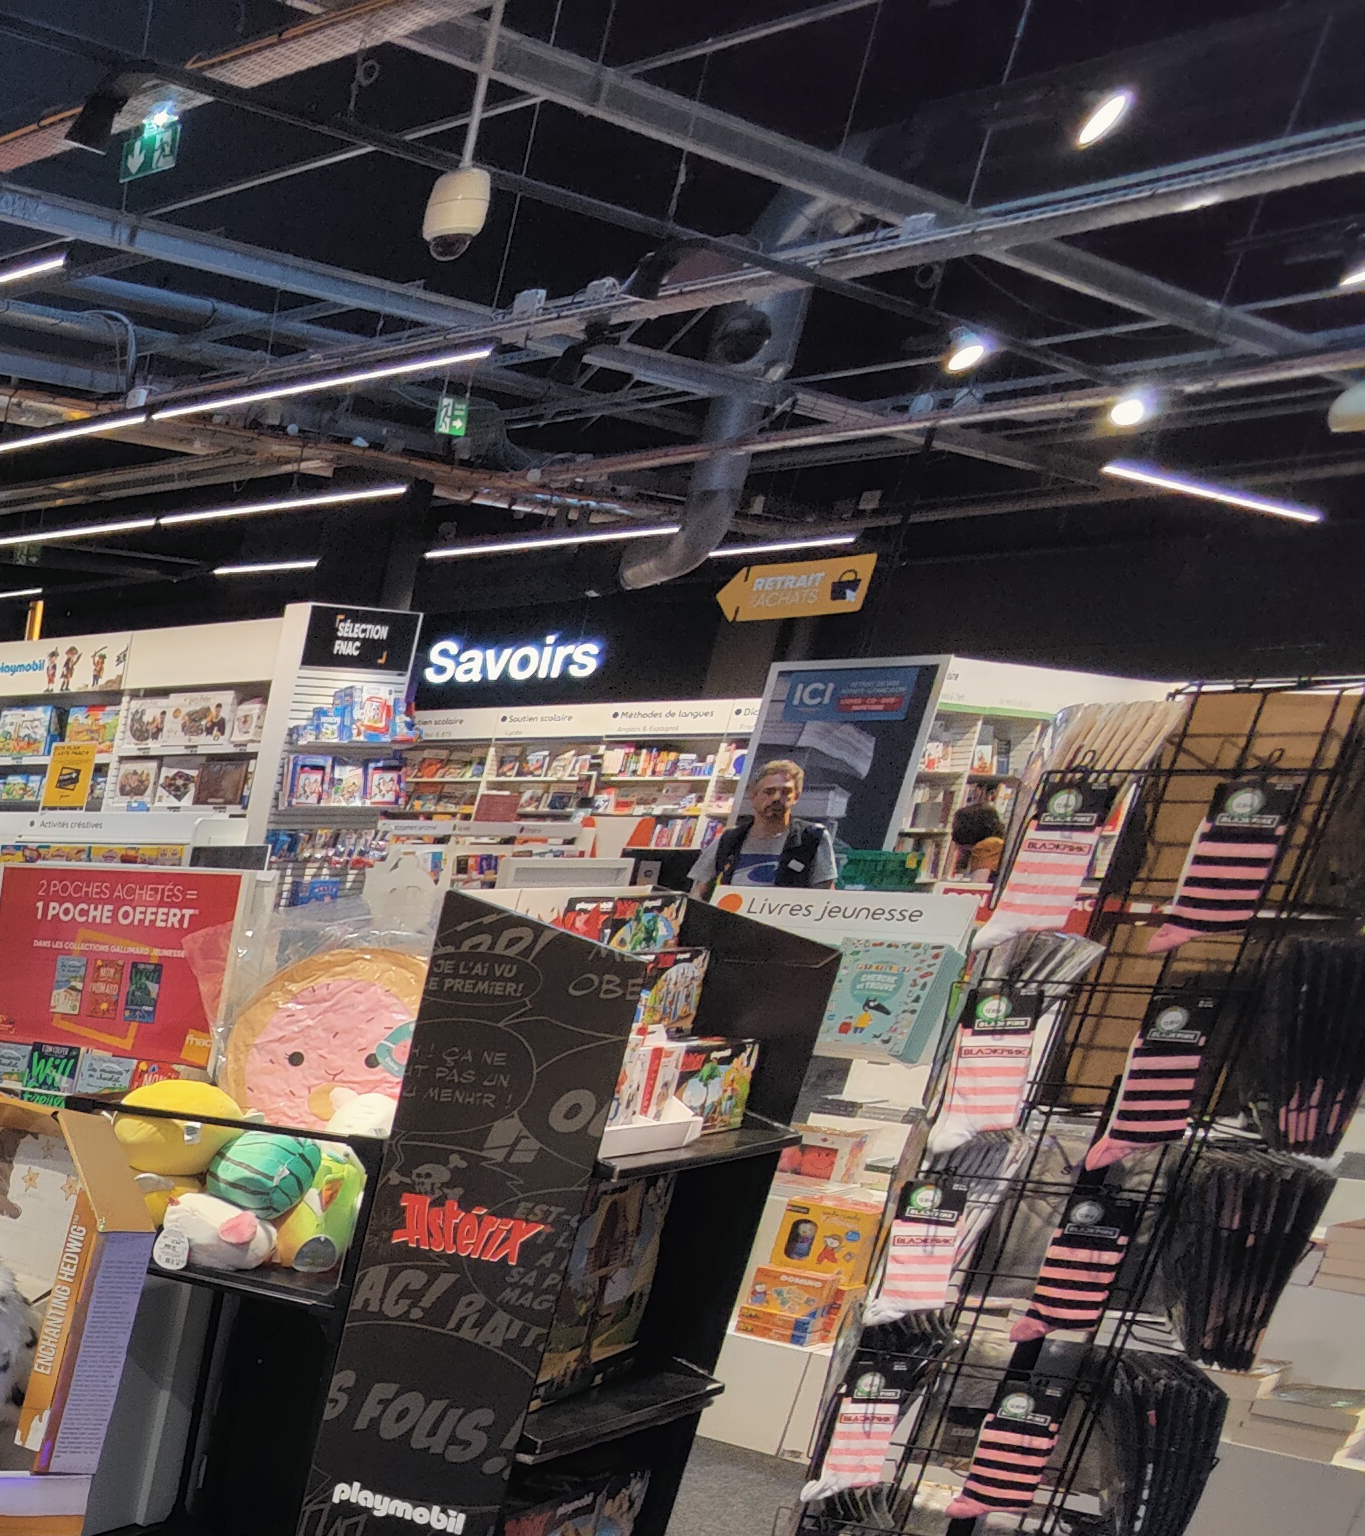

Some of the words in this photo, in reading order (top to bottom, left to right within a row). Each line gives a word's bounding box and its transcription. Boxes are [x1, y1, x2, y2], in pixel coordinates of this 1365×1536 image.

[753, 572, 825, 592] RETRAIT
[337, 619, 388, 640] SÉLECTION
[333, 641, 360, 656] FNAC
[424, 632, 599, 683] Savoirs
[792, 682, 835, 706] ICI
[508, 713, 538, 723] Soutien
[540, 713, 573, 723] scolaire
[620, 709, 661, 720] Méthodes
[664, 710, 676, 718] de
[678, 708, 715, 720] langues
[39, 820, 69, 830] Activités
[70, 821, 103, 830] créatives
[37, 880, 48, 896] 2
[50, 881, 110, 899] POCHES
[113, 882, 183, 902] ACHETÉS
[36, 901, 43, 920] 1
[48, 903, 112, 925] POCHE
[118, 906, 195, 929] OFFERT
[746, 897, 812, 918] Livres
[814, 899, 924, 924] jeunesse
[33, 940, 50, 948] DANS
[52, 941, 63, 949] LES
[64, 941, 108, 951] COLLECTIONS
[110, 945, 149, 954] GALLIMARD
[152, 948, 185, 958] JEUNESSE
[391, 1192, 547, 1265] Astérix
[780, 1275, 823, 1288] DOMINO
[353, 1382, 496, 1463] FOUS
[332, 1481, 466, 1536] playmobil
